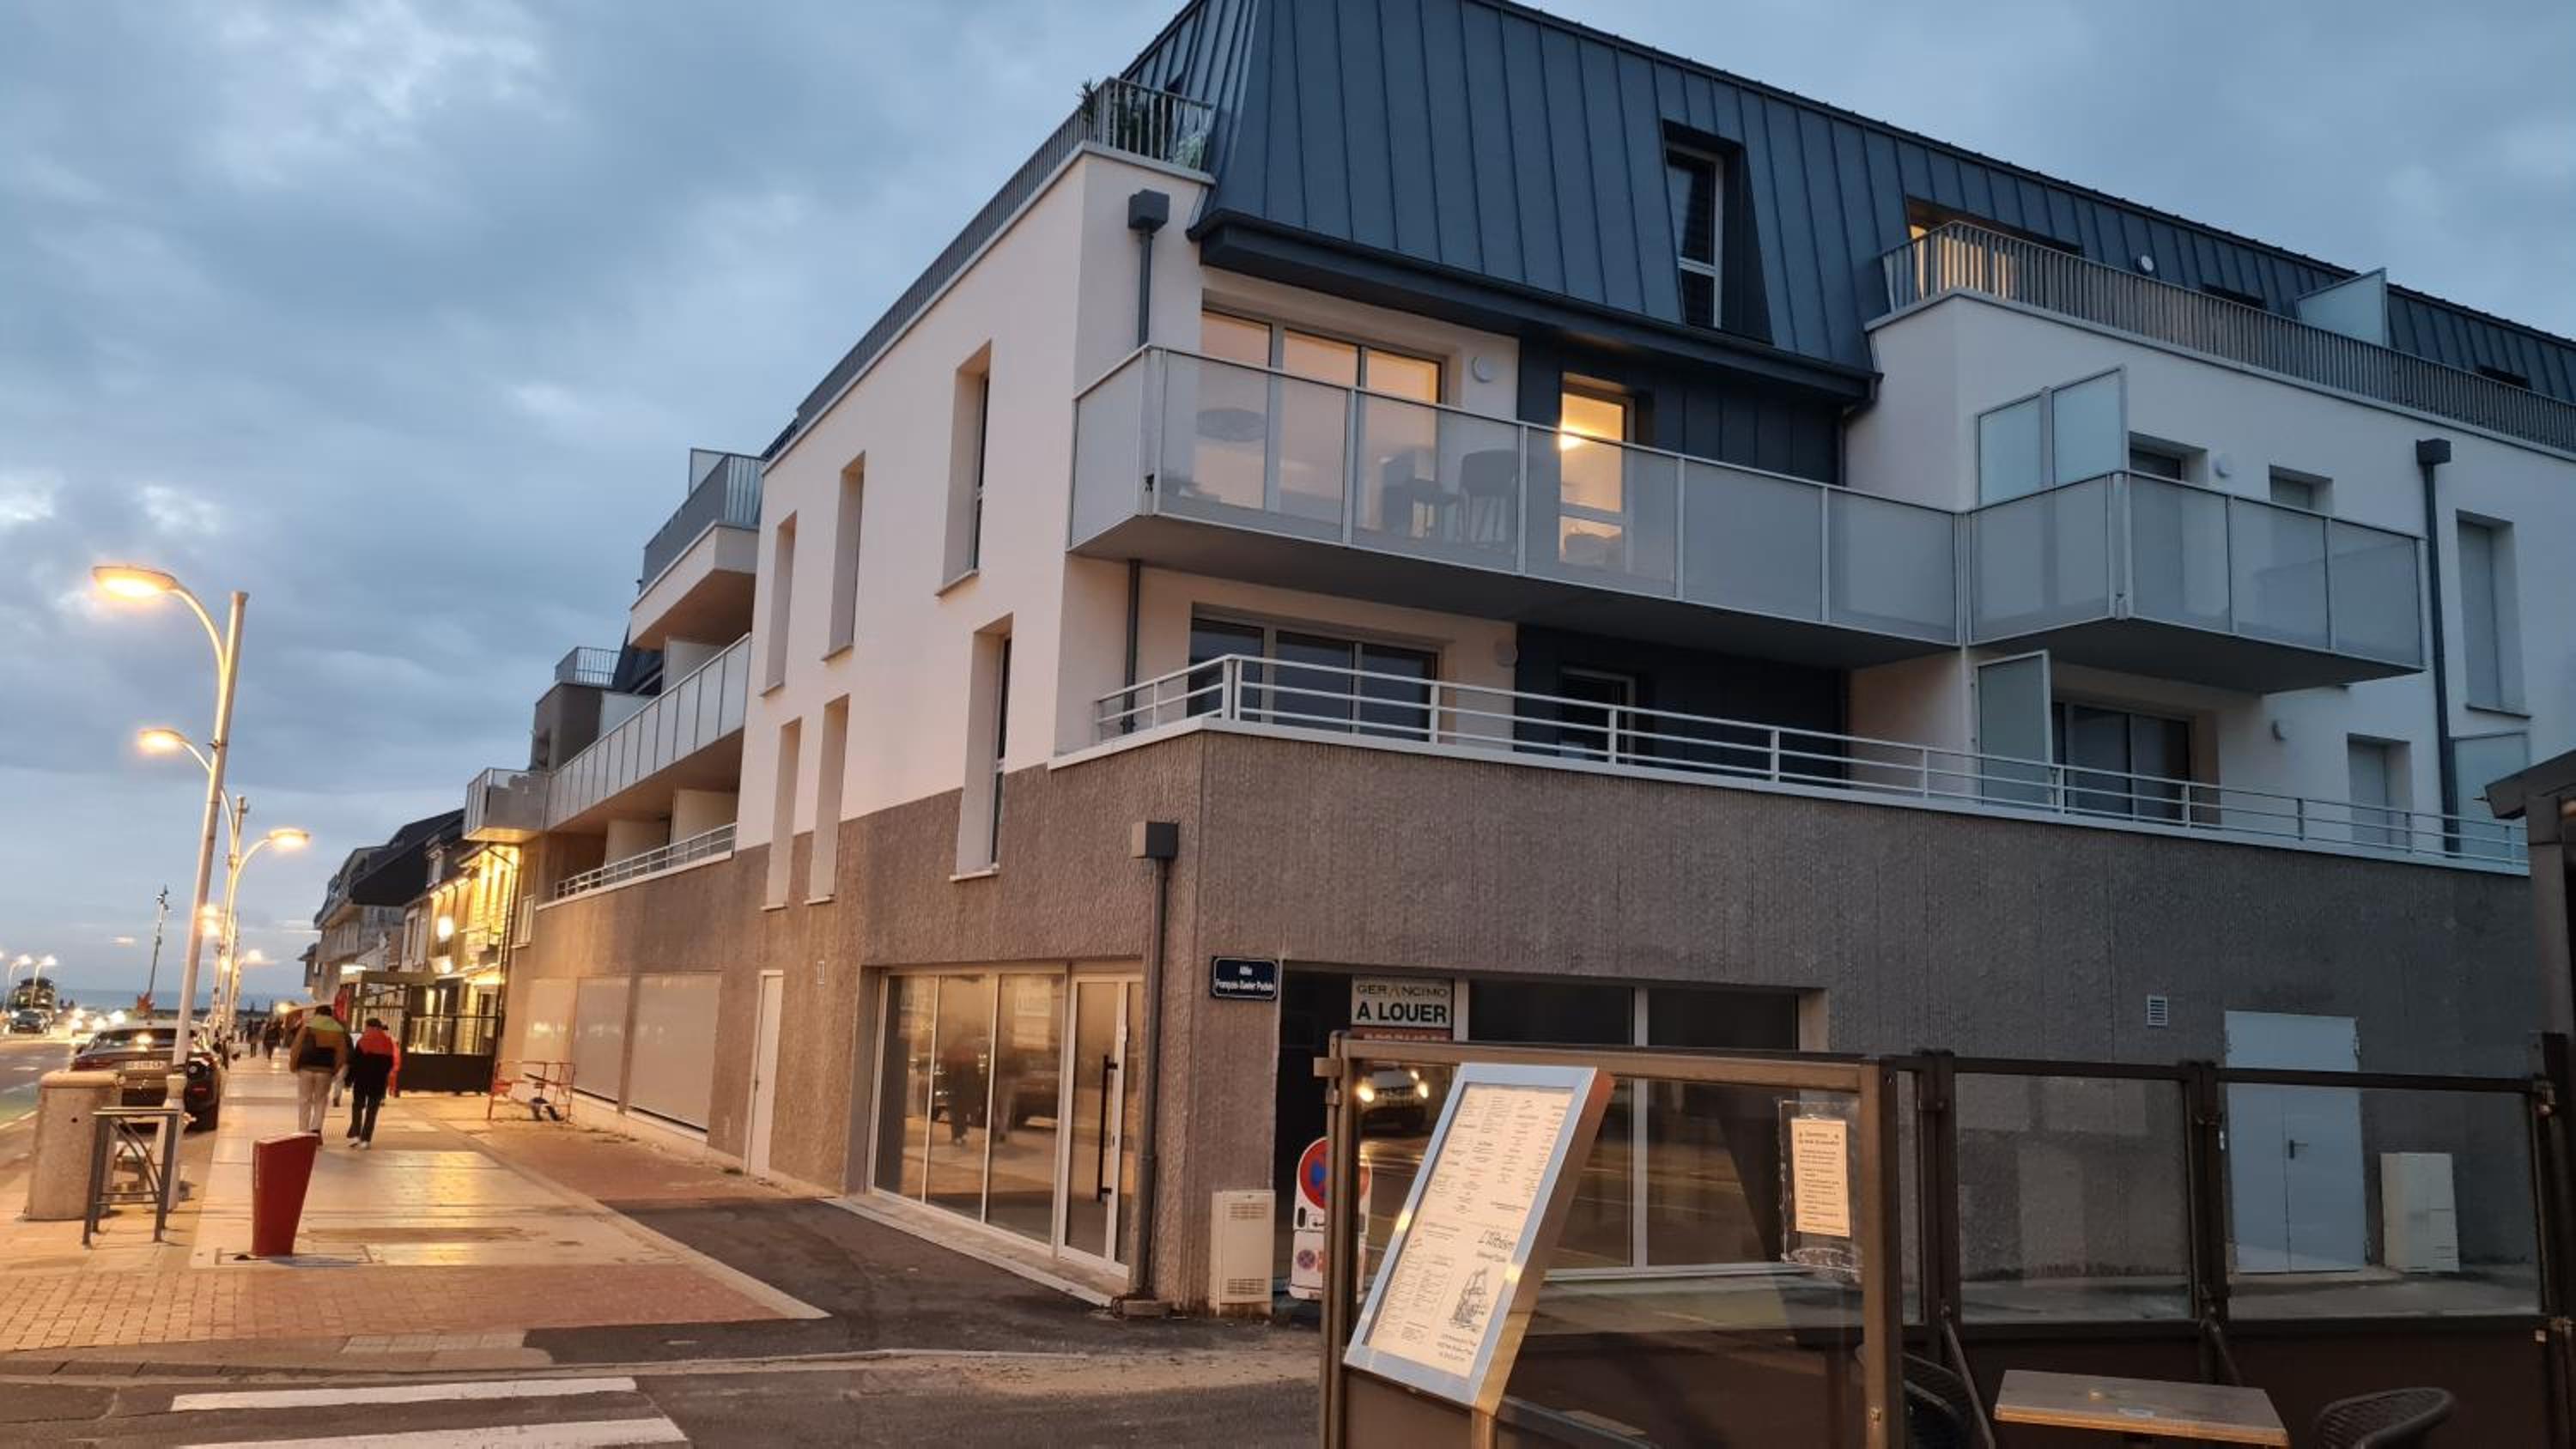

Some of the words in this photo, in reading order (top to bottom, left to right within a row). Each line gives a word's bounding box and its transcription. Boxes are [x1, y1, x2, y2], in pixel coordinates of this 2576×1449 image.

[1357, 984, 1448, 998] GERANCIMO
[1357, 1002, 1371, 1020] A
[1378, 1003, 1447, 1023] LOUER
